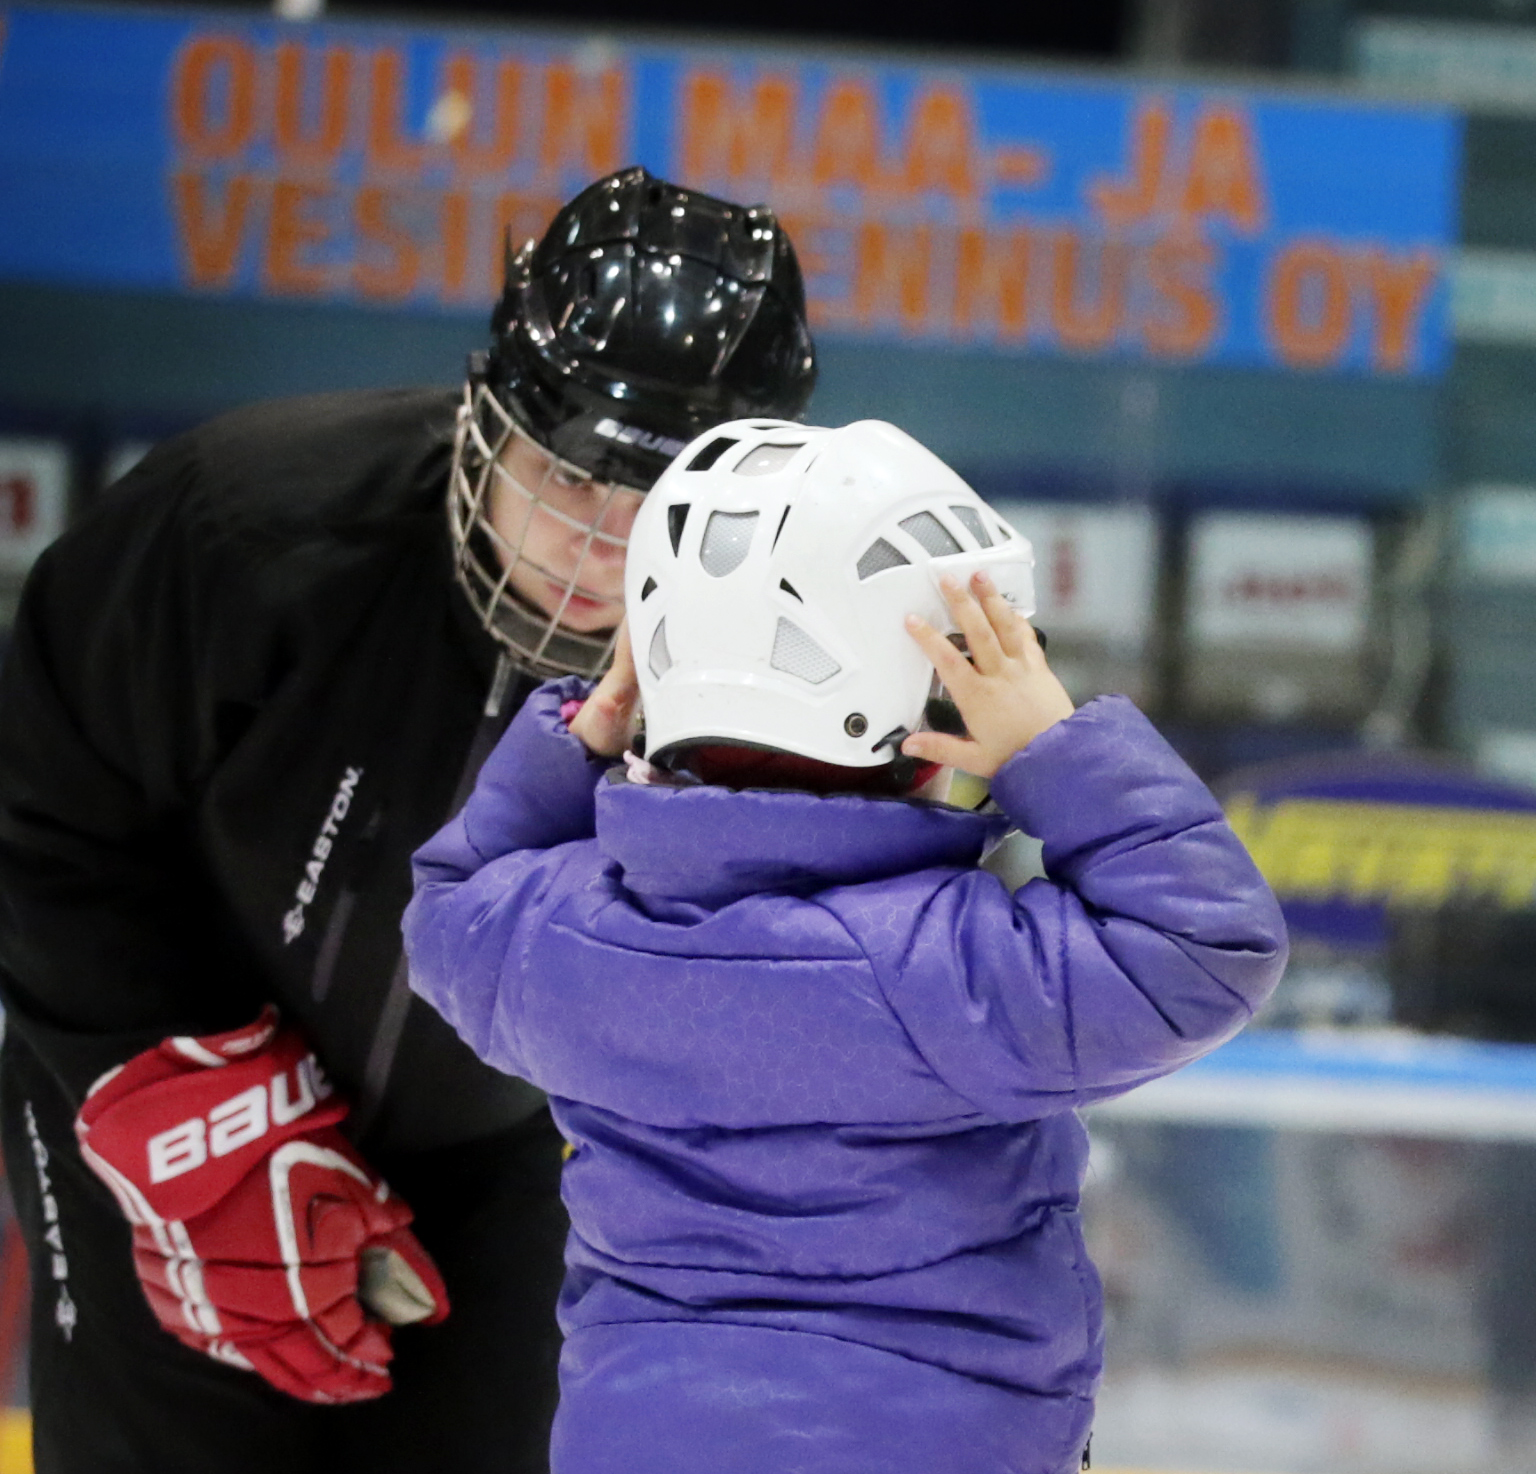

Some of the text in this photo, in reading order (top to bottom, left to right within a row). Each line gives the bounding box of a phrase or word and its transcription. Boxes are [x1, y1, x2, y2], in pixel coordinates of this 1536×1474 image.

[170, 34, 1266, 236] OULUN MAA- JA
[1266, 236, 1444, 373] OY
[296, 766, 359, 904] EASTON
